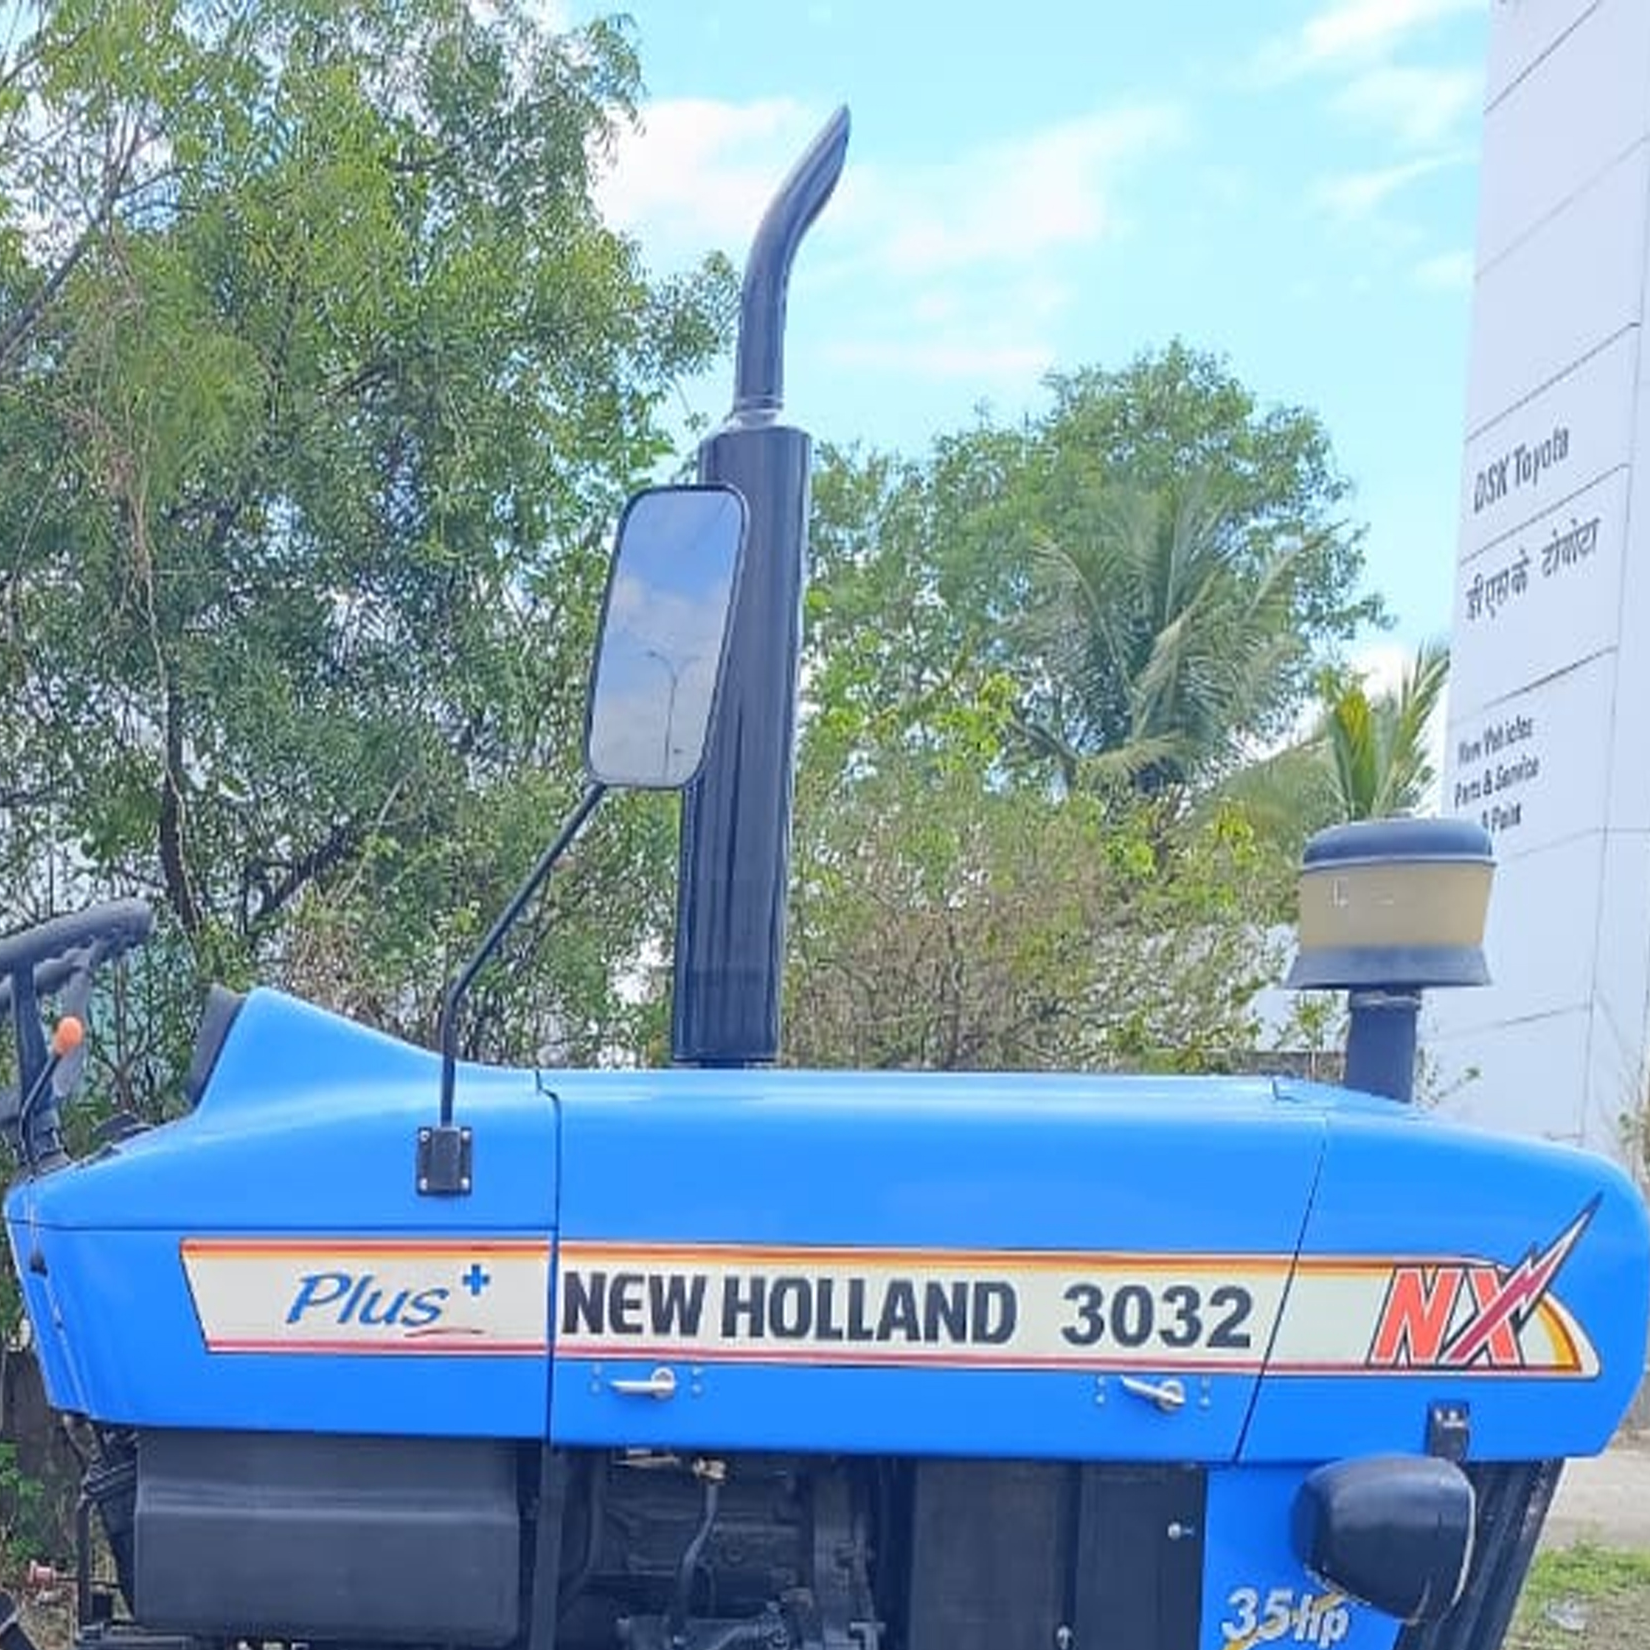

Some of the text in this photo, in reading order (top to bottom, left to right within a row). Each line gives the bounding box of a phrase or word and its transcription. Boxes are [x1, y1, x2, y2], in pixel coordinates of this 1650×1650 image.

[1474, 427, 1568, 514] DSK Toyota
[561, 1271, 1252, 1349] NEW HOLLAND 3032
